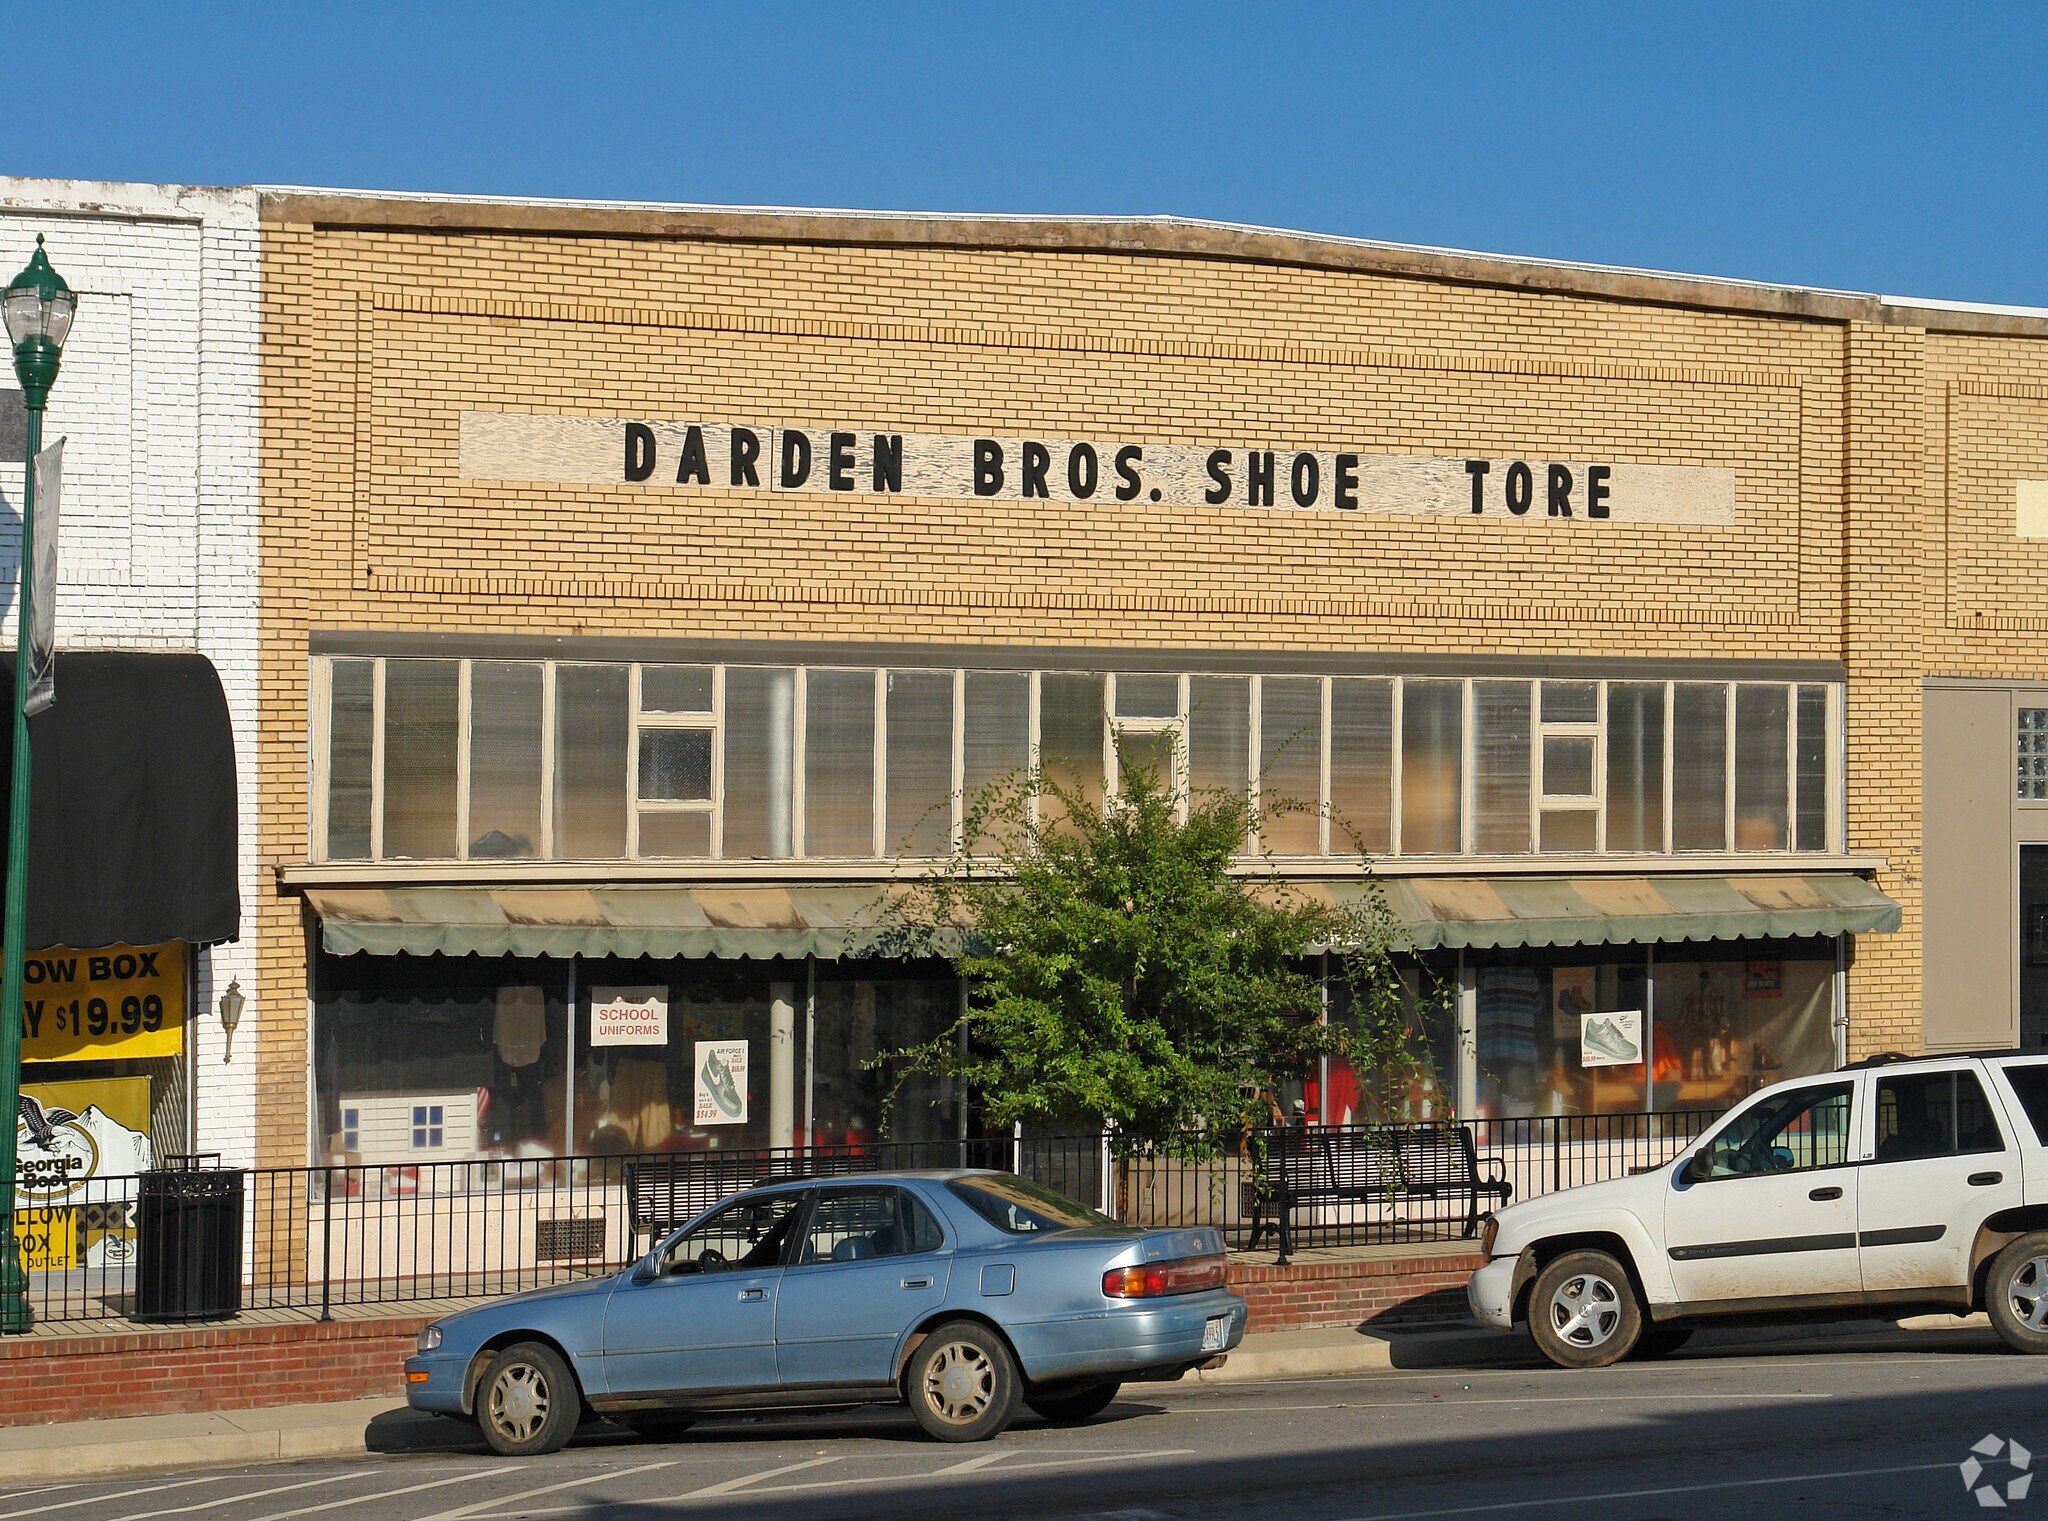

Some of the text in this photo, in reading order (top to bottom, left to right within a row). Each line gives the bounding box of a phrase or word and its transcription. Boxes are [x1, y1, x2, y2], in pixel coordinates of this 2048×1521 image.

[624, 422, 1611, 519] DARDEN BROS. SHOE TORE
[88, 952, 160, 981] BOX
[56, 994, 163, 1036] $19.99
[599, 1009, 659, 1021] SCHOOL
[599, 1025, 660, 1036] UNIFORMS
[27, 1256, 70, 1268] OUTLET
